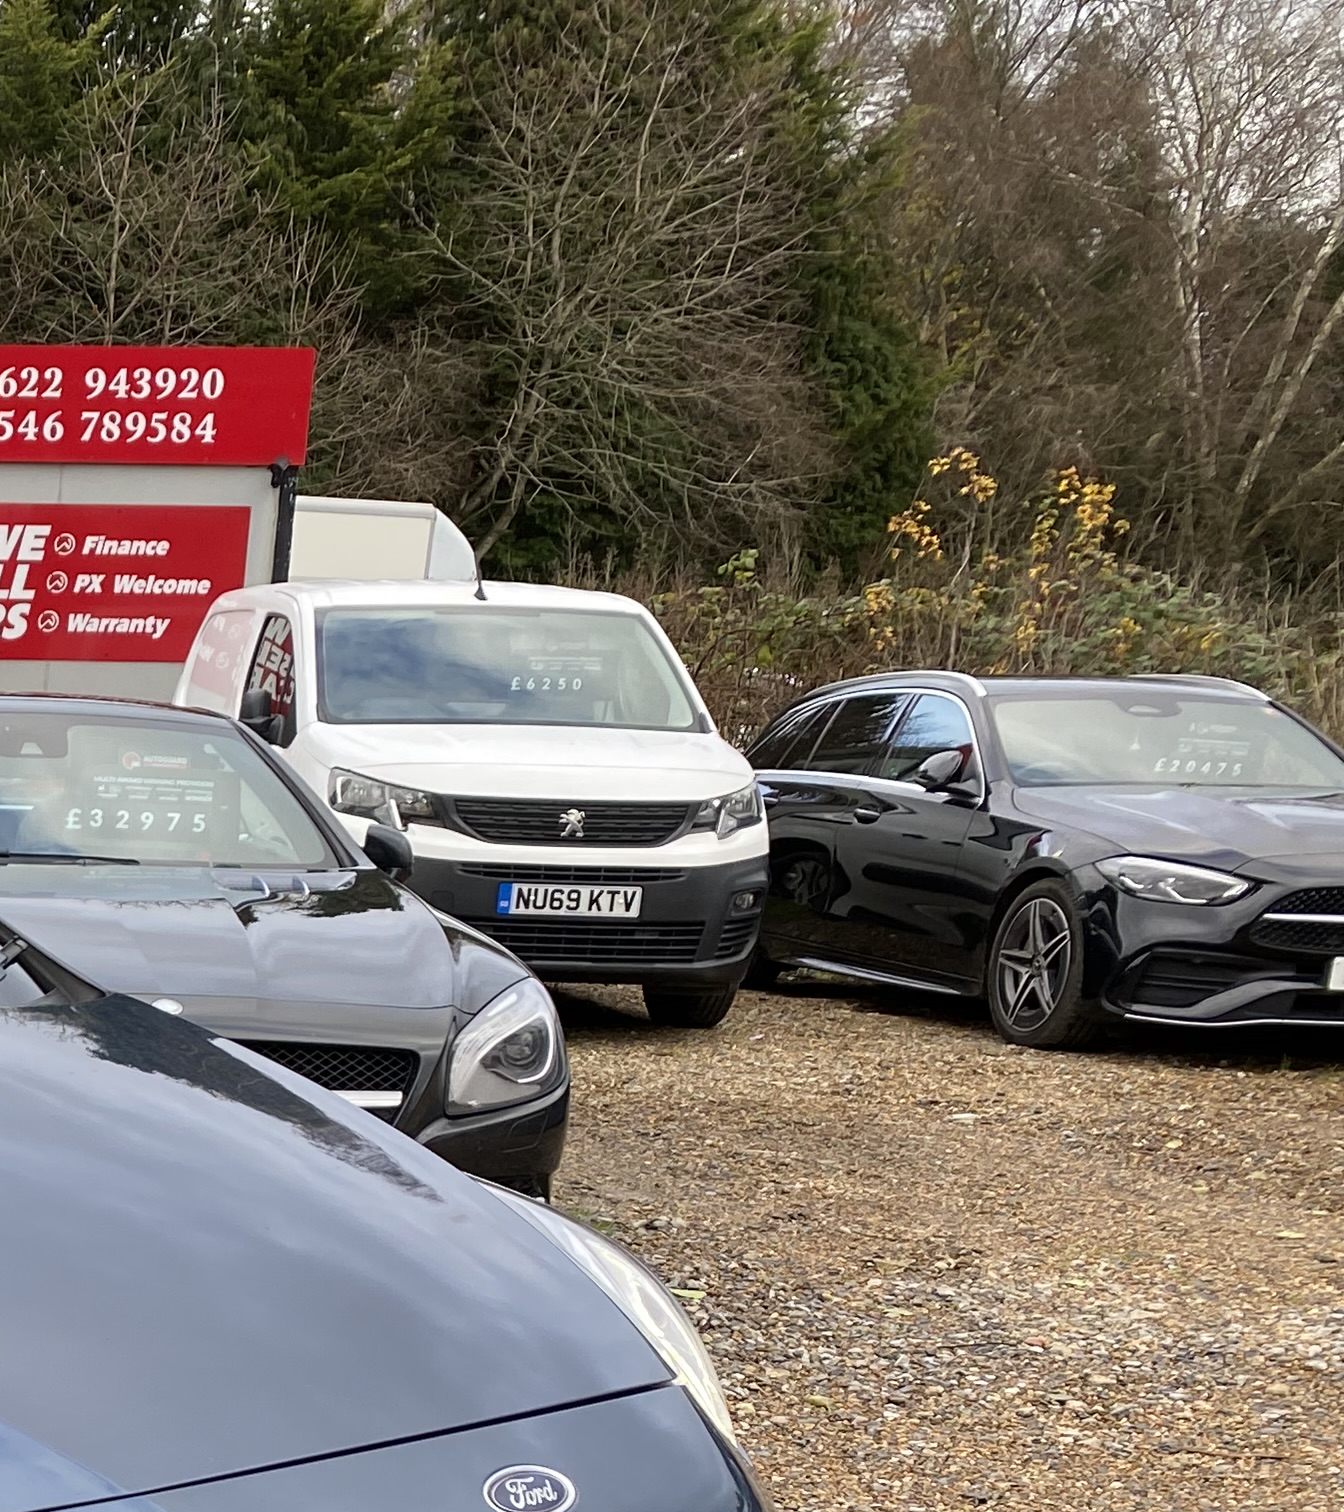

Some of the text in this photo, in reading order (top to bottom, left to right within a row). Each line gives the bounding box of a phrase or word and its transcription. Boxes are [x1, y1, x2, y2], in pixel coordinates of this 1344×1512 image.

[84, 366, 225, 400] 943920
[80, 410, 217, 444] 789584
[81, 535, 170, 557] Finance
[73, 574, 211, 596] PX Welcome
[67, 613, 171, 639] Warranty
[510, 676, 582, 691] £6250
[1154, 758, 1242, 777] £20475
[65, 807, 206, 833] £32975
[515, 887, 637, 913] NU69 KTV
[505, 1476, 558, 1509] Ford
